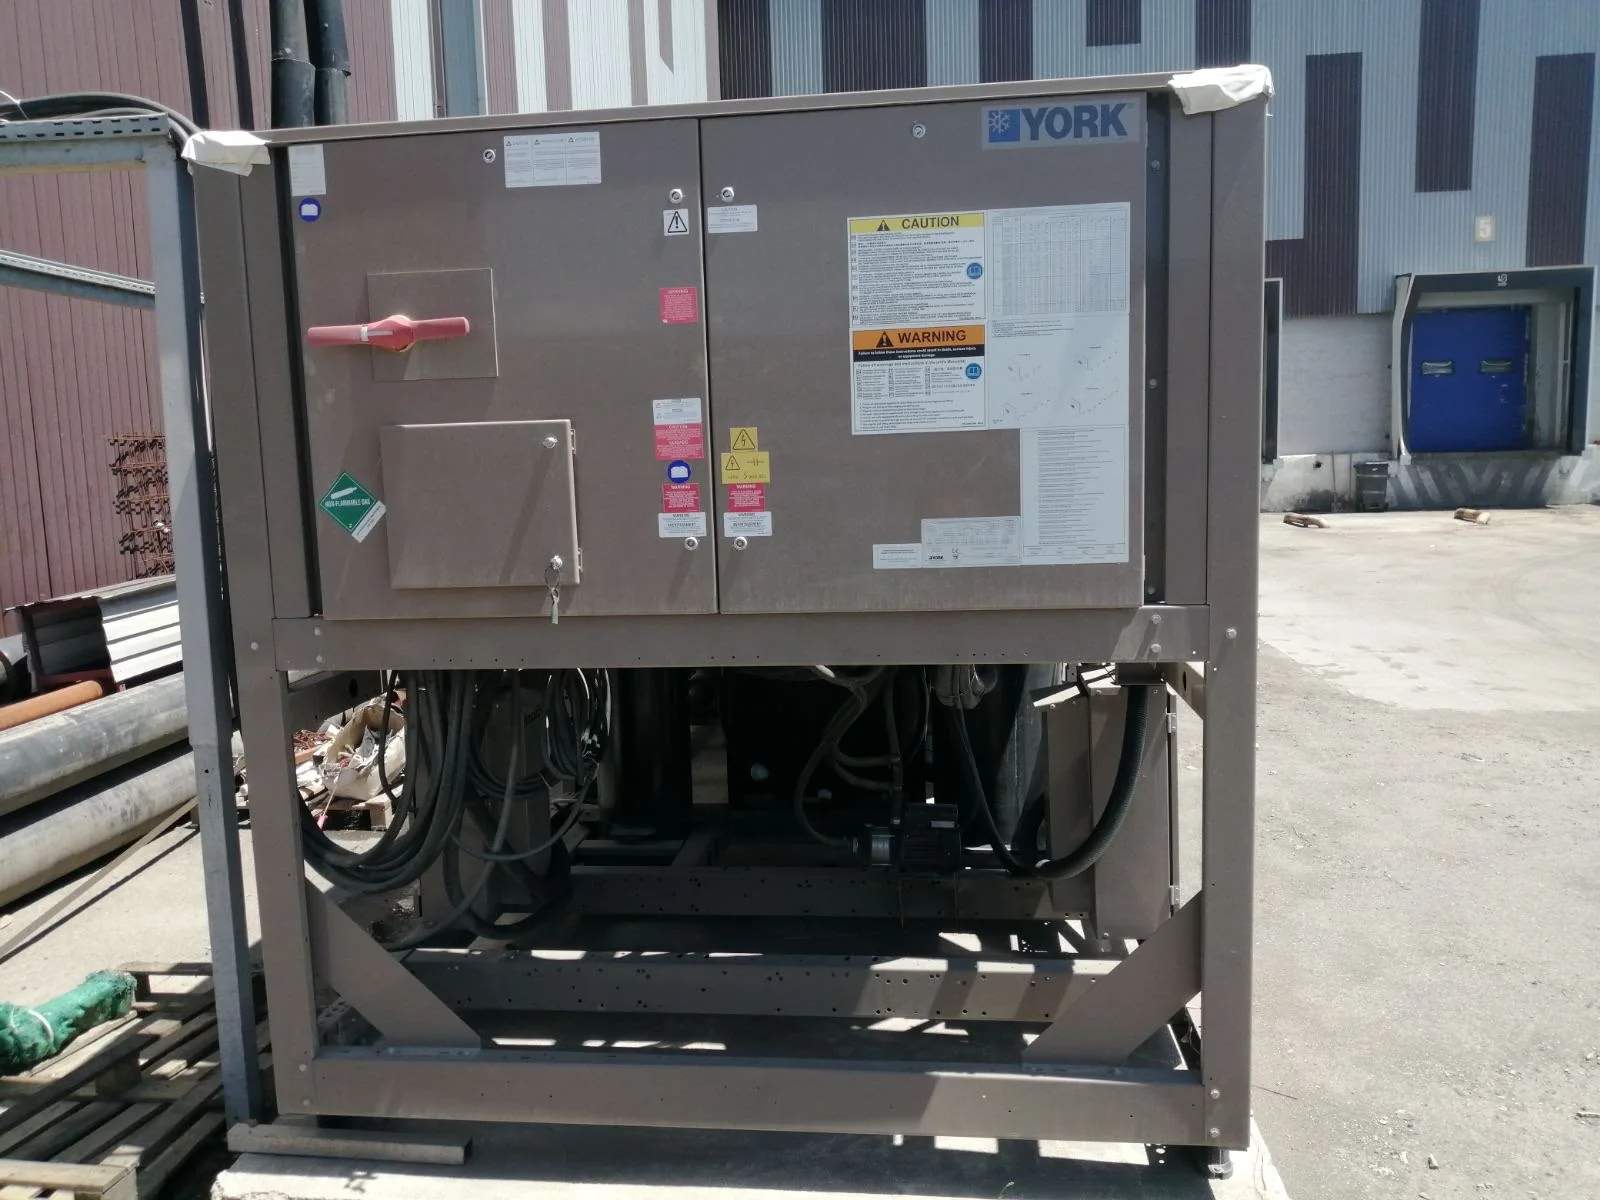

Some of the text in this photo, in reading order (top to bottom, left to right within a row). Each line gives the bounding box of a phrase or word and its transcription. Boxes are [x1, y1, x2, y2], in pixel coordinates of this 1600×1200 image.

[1021, 103, 1128, 141] YORK
[901, 215, 959, 230] CAUTION
[898, 329, 967, 344] WARNING
